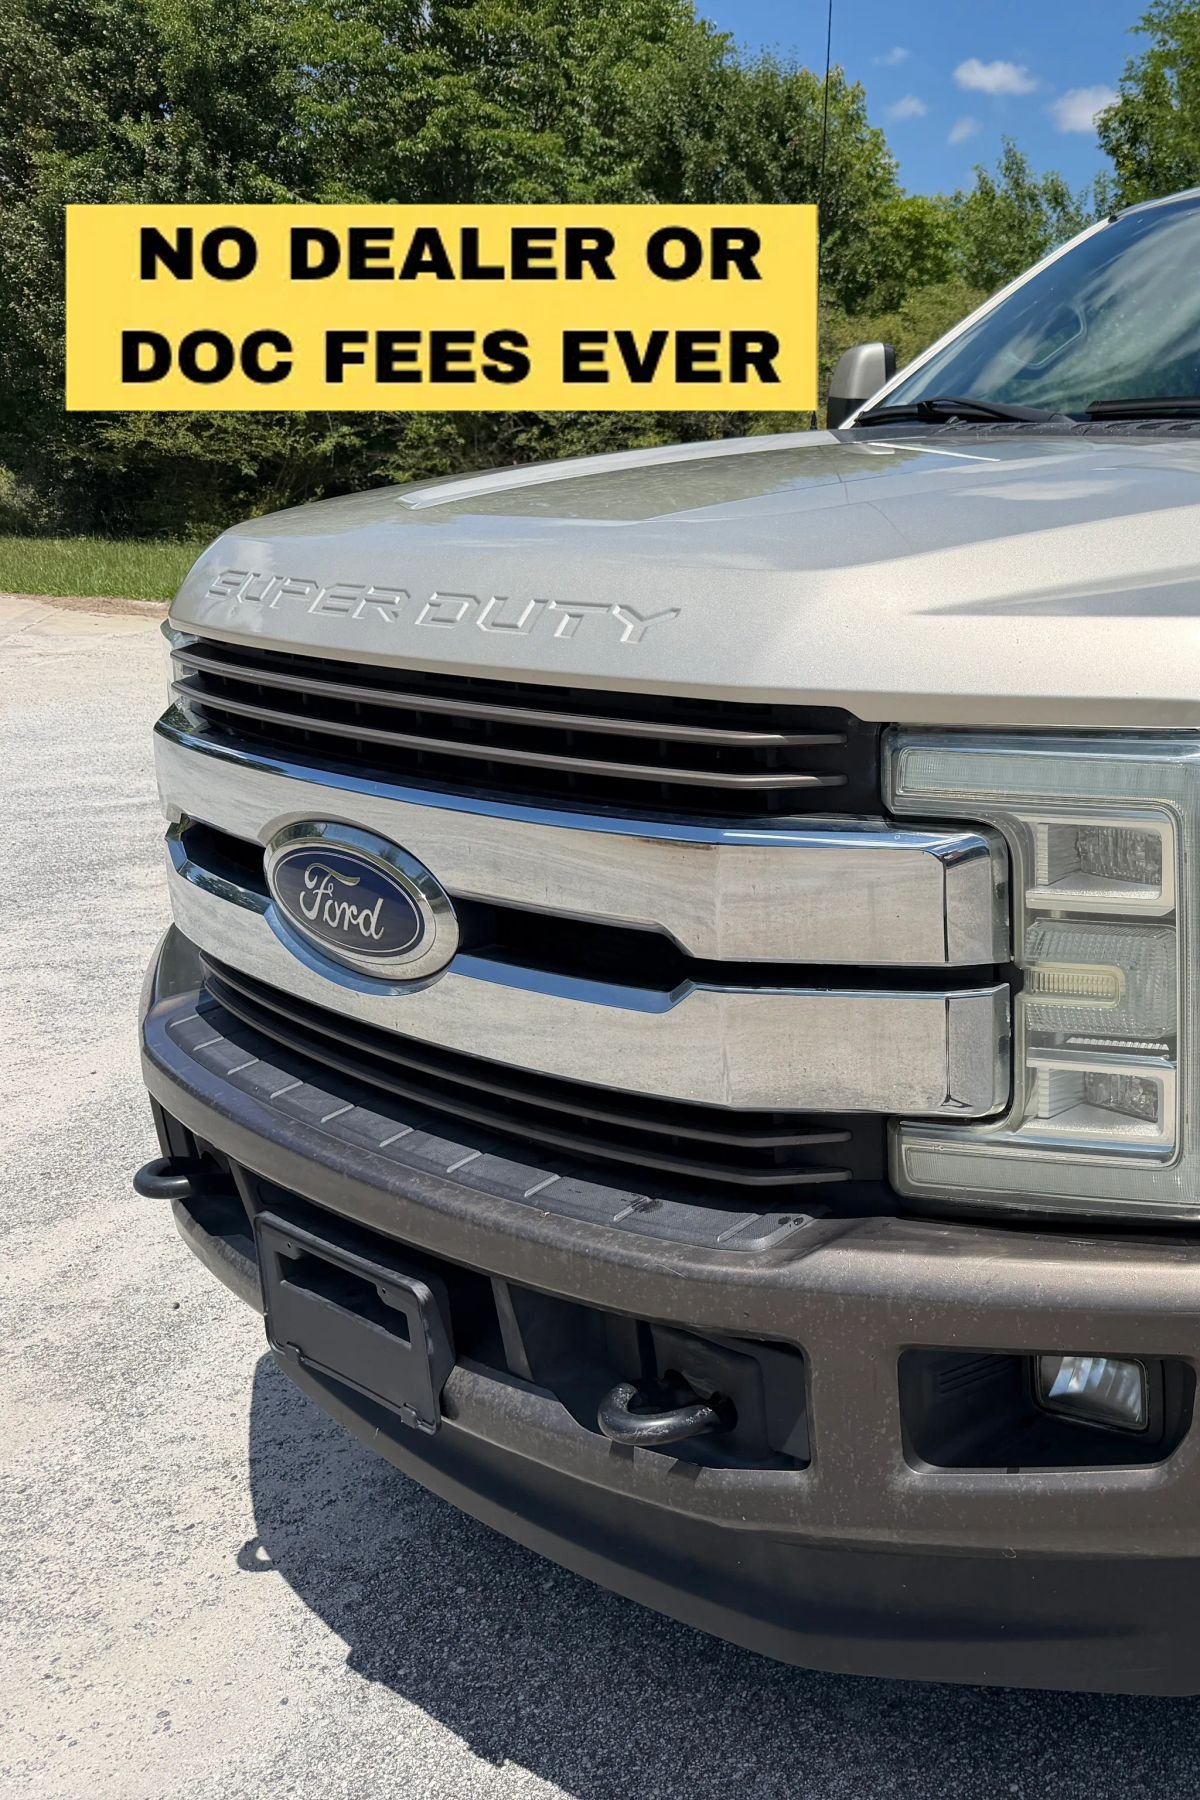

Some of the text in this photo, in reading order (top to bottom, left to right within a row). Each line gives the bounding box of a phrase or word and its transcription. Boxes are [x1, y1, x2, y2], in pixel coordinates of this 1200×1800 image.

[206, 569, 681, 645] SUPER DUTY
[300, 862, 385, 940] Ford
